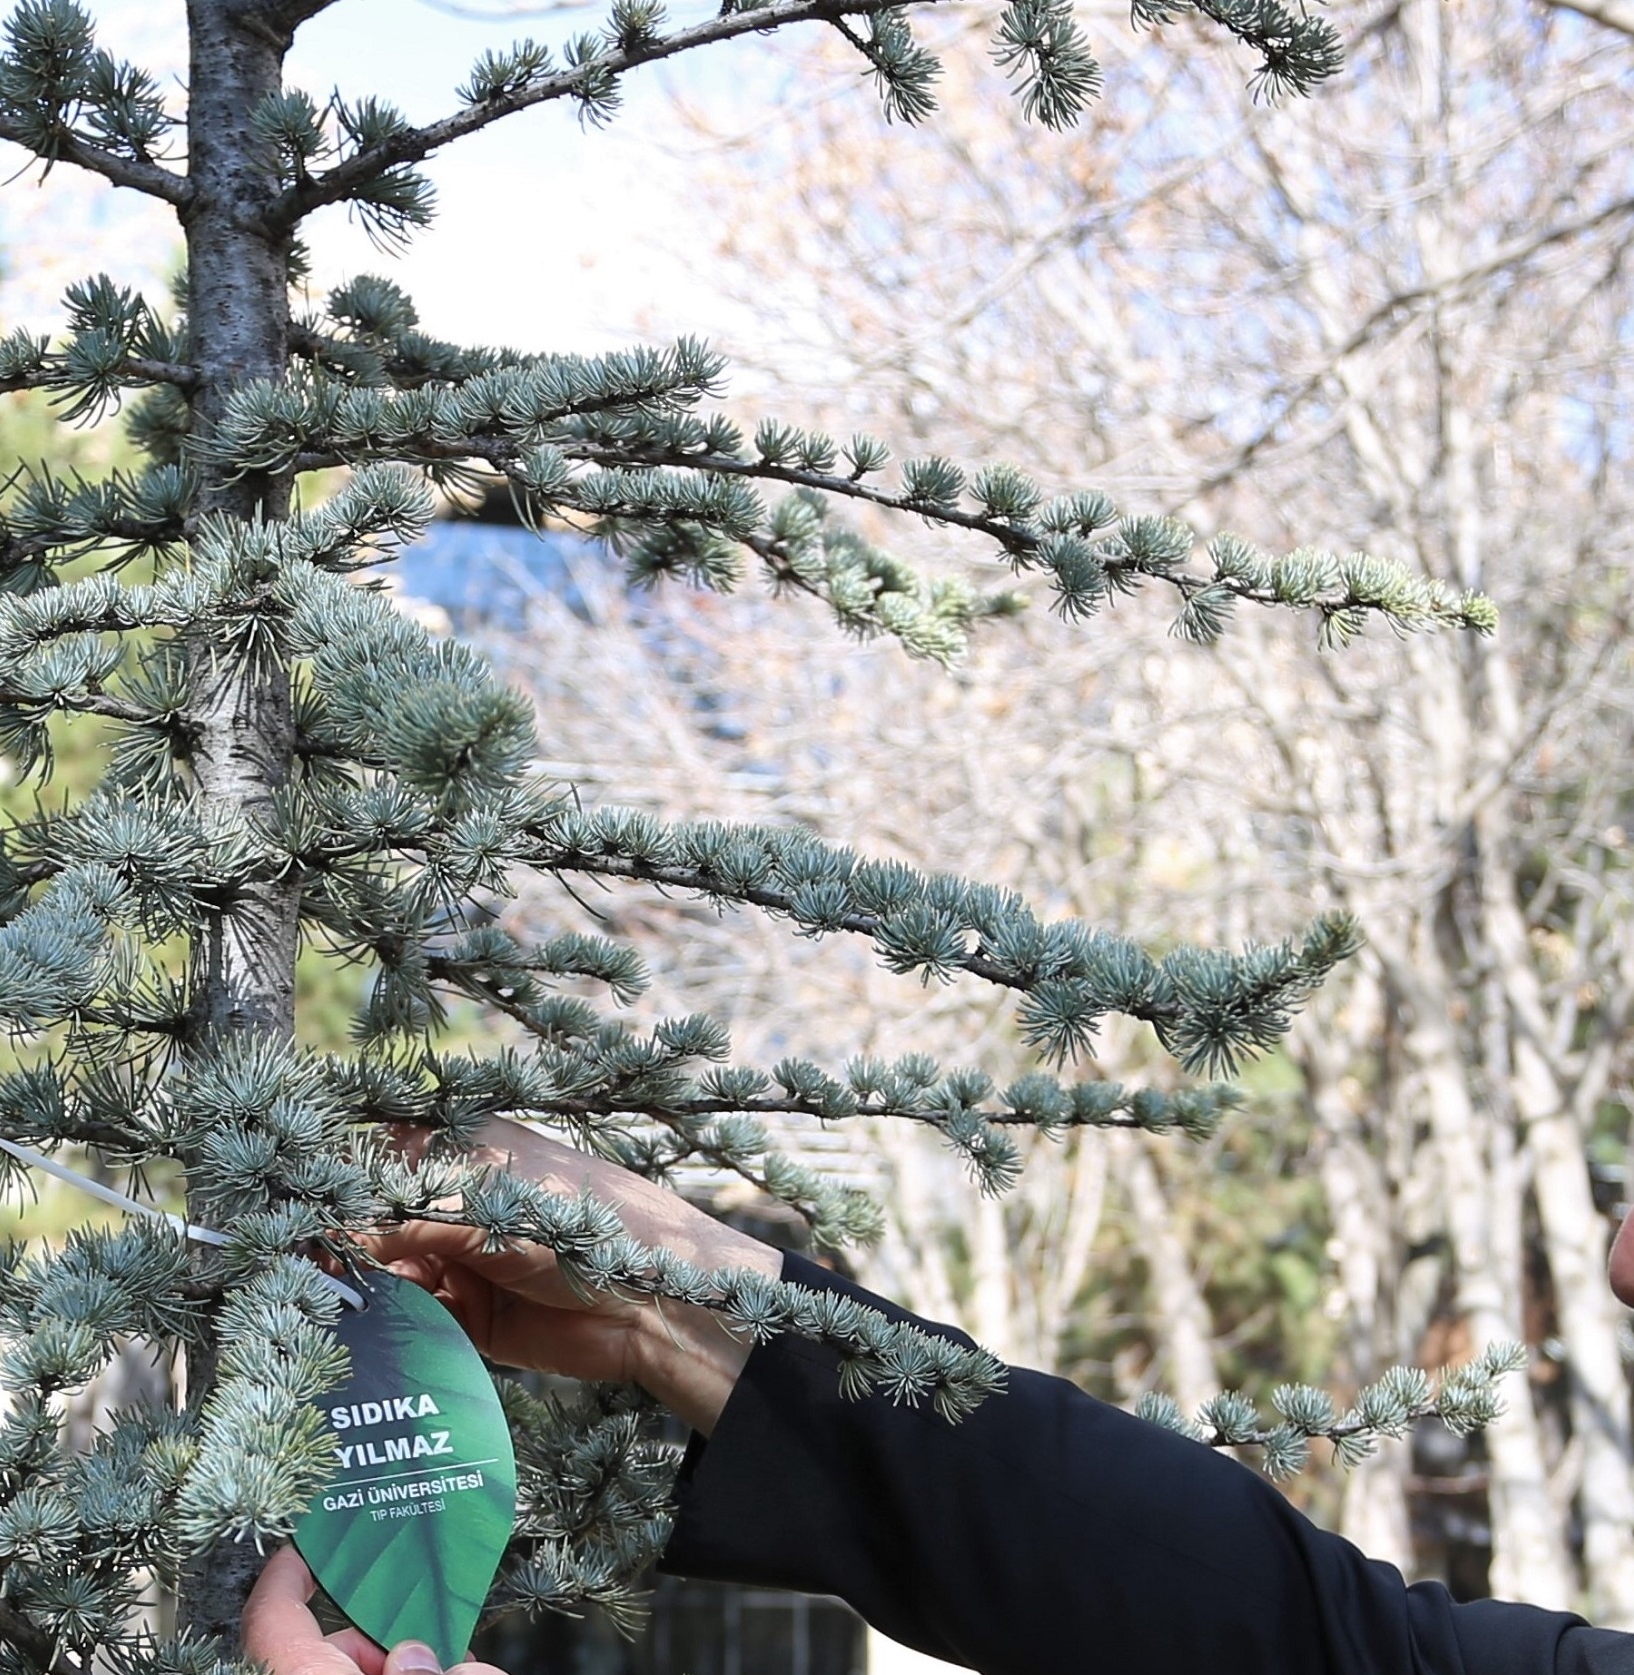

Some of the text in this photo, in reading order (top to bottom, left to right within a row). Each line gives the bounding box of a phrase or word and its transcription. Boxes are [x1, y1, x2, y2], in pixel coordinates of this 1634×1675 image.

[331, 1394, 439, 1429] SIDIKA
[334, 1431, 453, 1469] YILMAZ
[323, 1469, 484, 1511] GAZİ ÜNİVERSİTESİ
[370, 1498, 446, 1522] TIP FAKÜLTESİ
